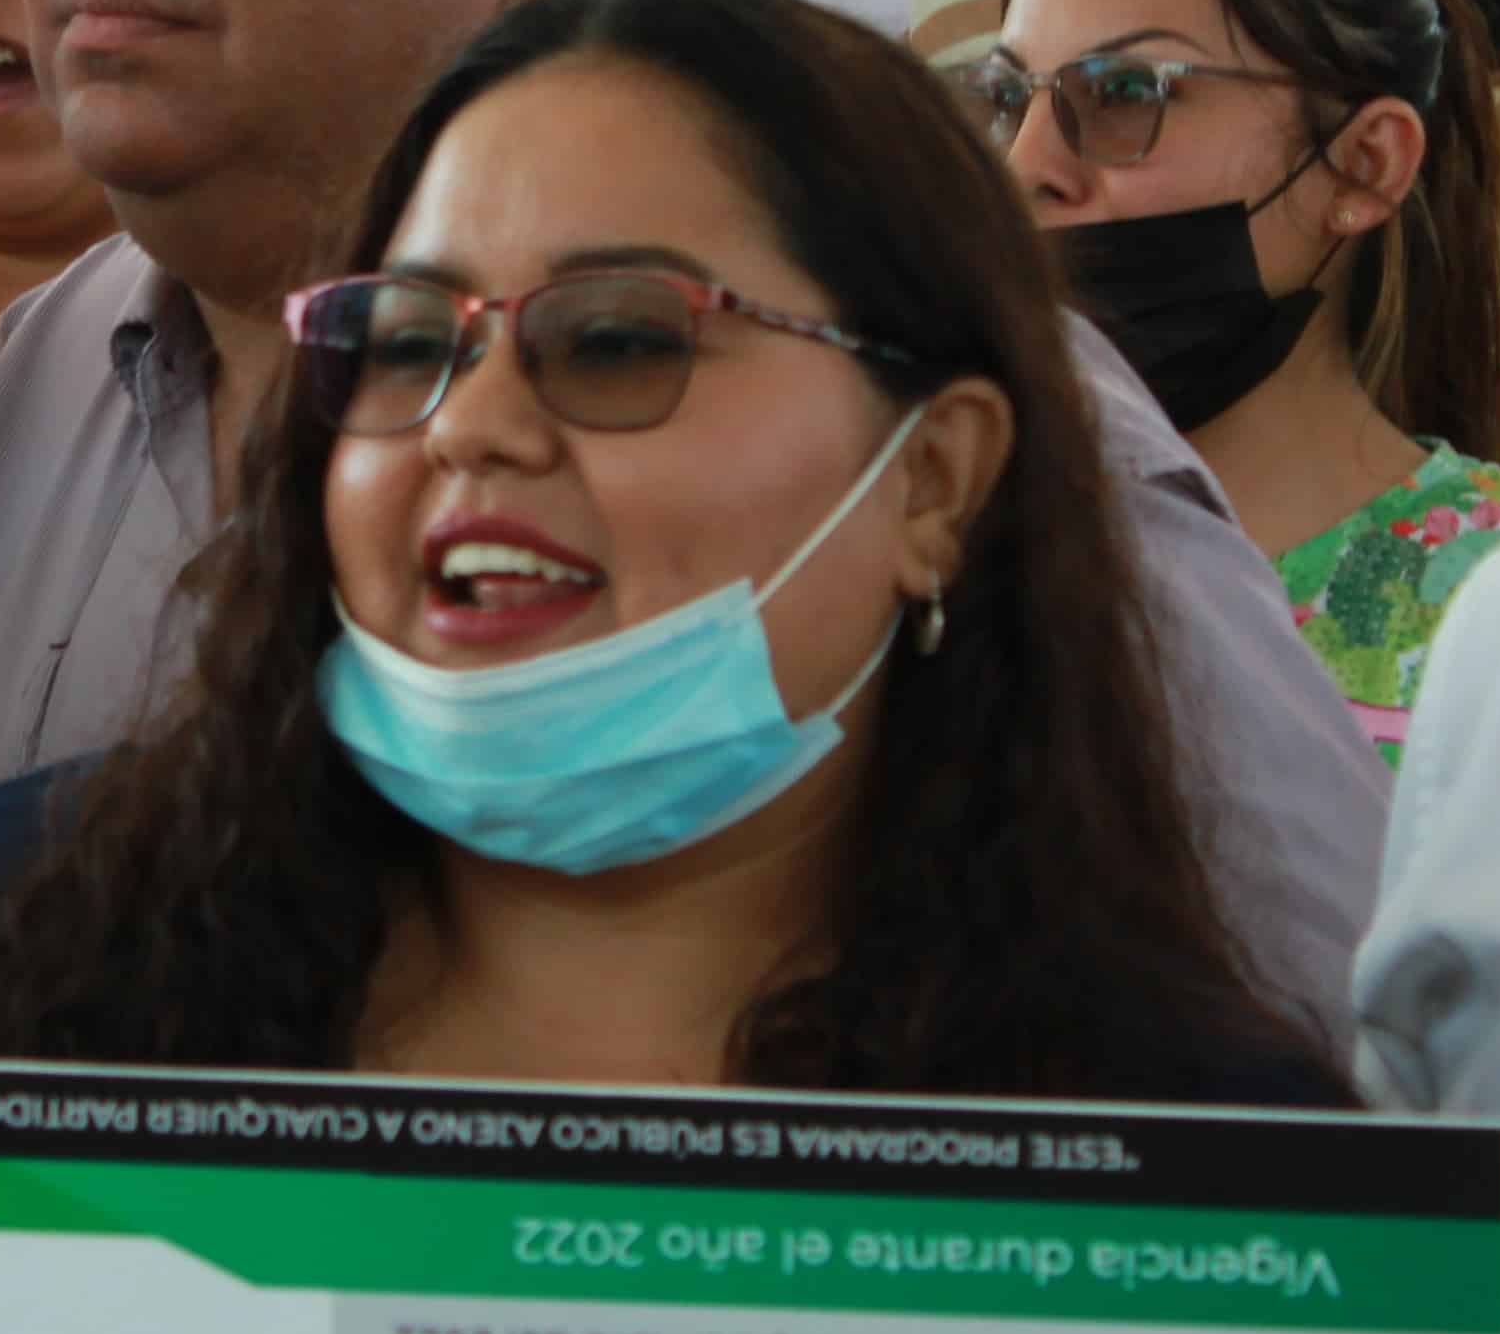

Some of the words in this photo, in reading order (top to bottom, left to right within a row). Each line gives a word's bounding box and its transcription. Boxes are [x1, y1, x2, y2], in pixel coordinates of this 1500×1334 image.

[145, 1097, 369, 1141] CUALQUIER
[374, 1111, 405, 1142] A
[410, 1110, 545, 1147] AJENO
[549, 1115, 723, 1158] PÚBLICO
[730, 1121, 781, 1157] ES
[787, 1126, 1020, 1167] PROGRAMA
[513, 1217, 643, 1268] 2022
[657, 1223, 766, 1272] año
[781, 1228, 832, 1275] el
[844, 1228, 1074, 1285] durante
[1087, 1235, 1339, 1296] Vigencia
